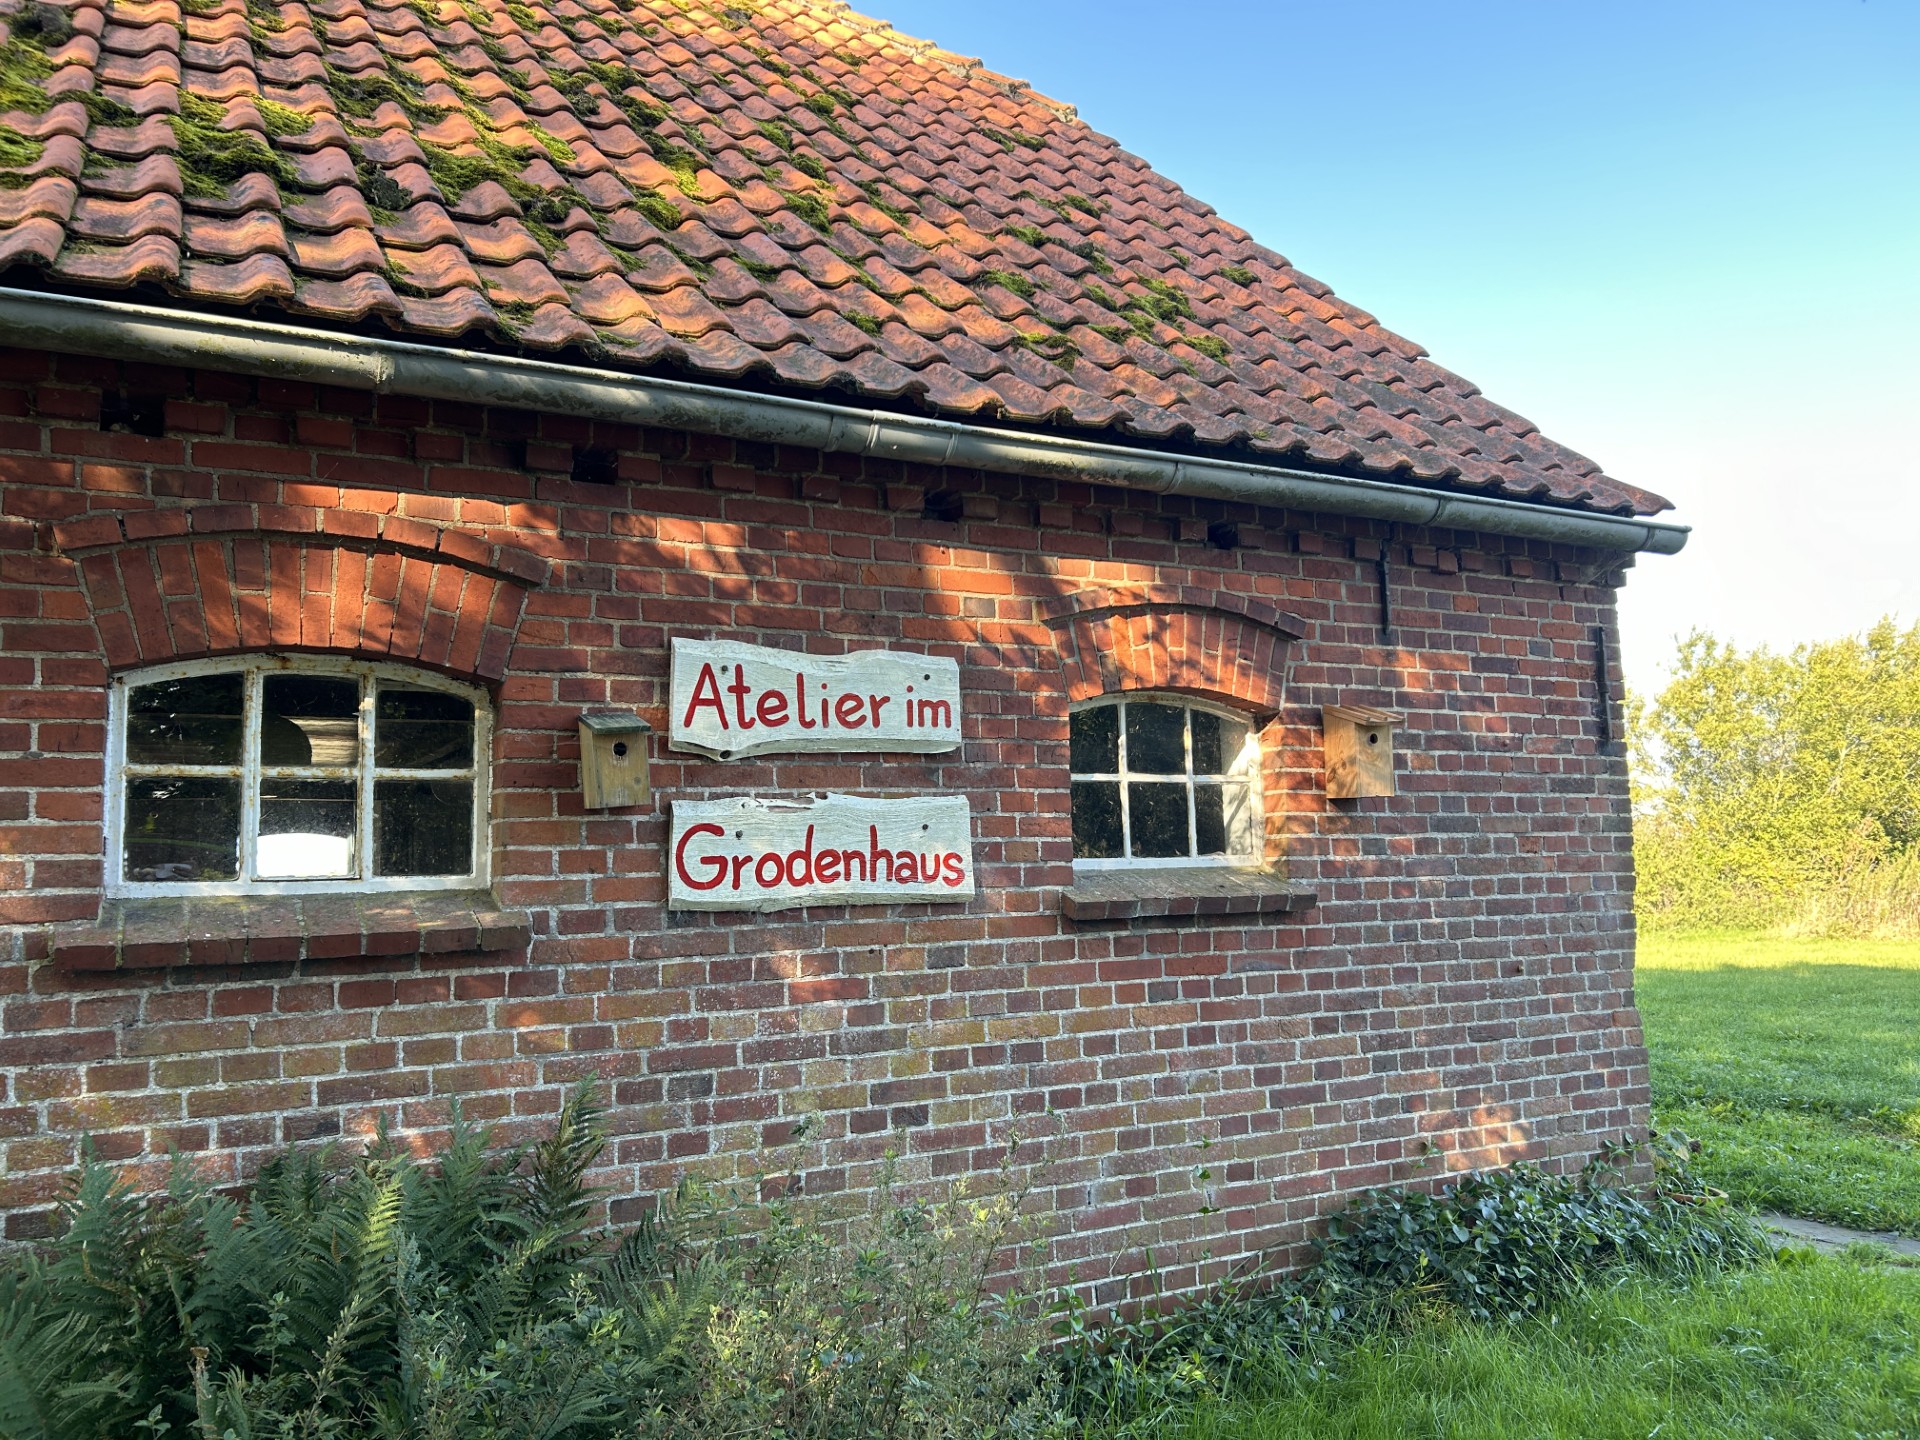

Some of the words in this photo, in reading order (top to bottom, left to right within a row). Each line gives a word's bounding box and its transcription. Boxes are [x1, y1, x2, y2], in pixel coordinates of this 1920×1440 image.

[683, 662, 891, 730] Atelier
[906, 685, 952, 728] im
[675, 823, 966, 890] Grodenhaus
